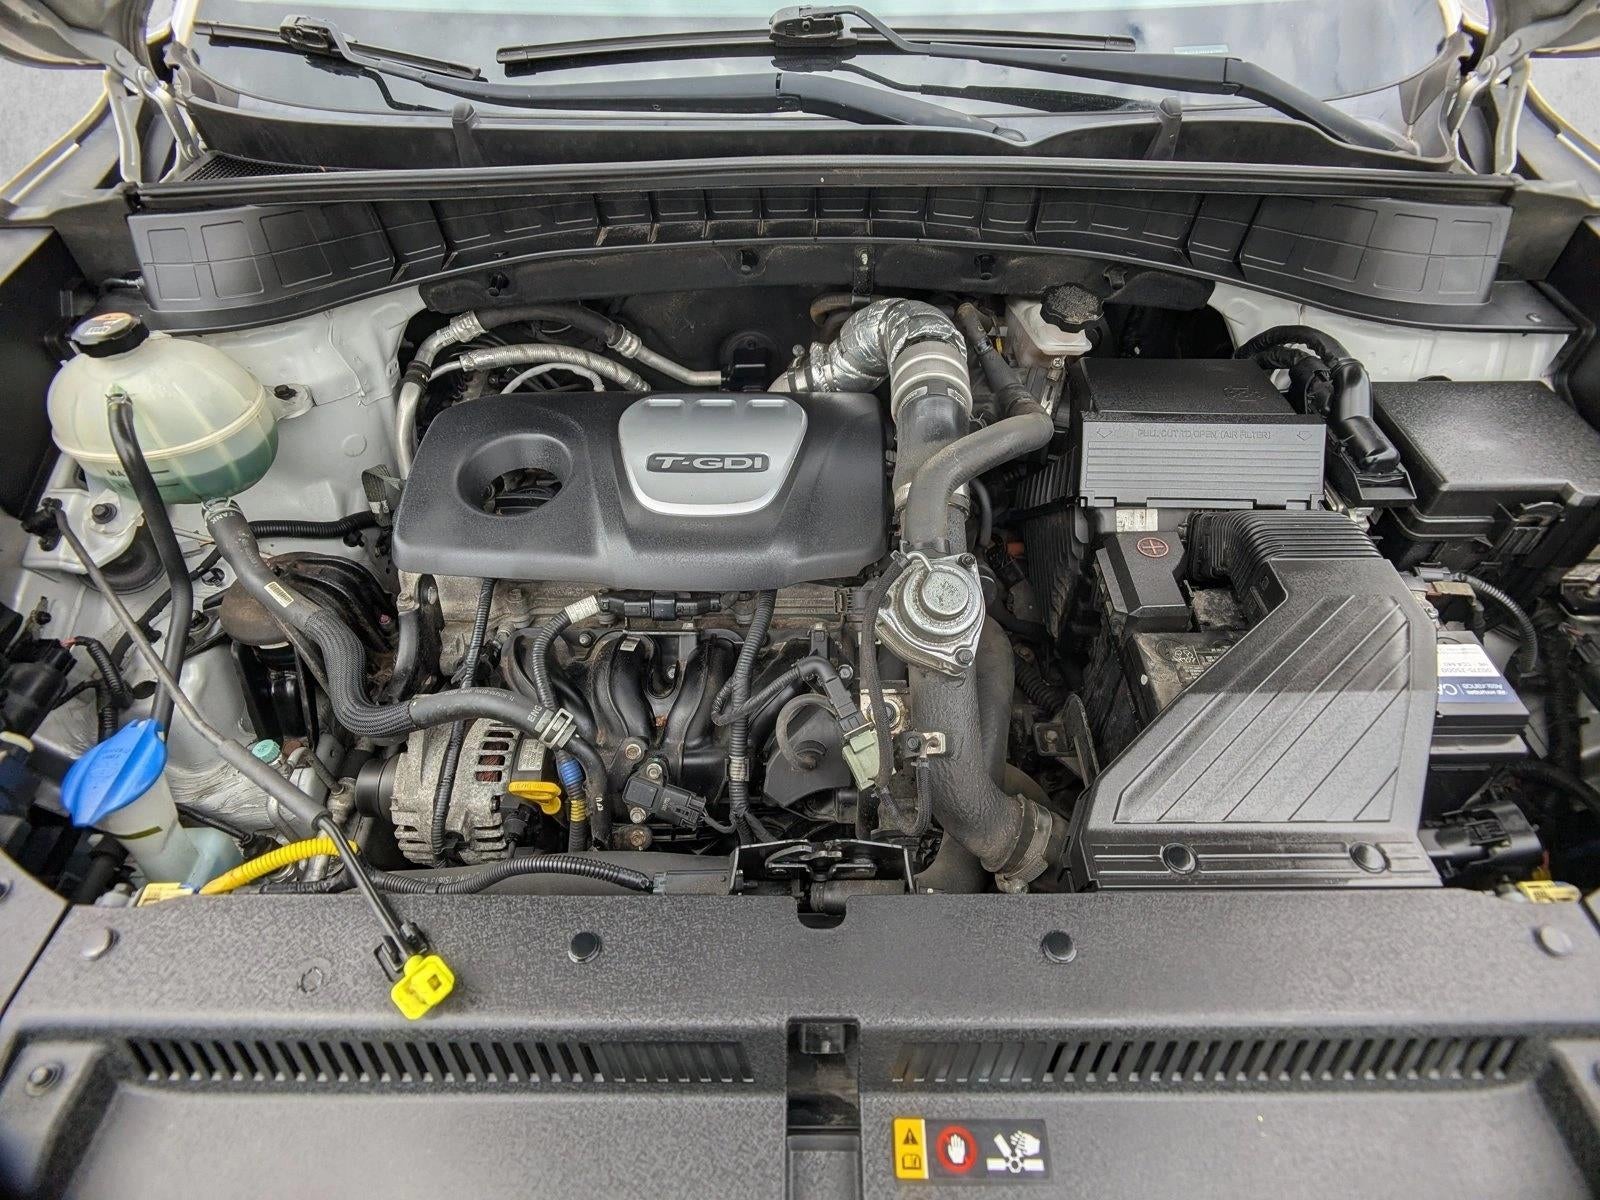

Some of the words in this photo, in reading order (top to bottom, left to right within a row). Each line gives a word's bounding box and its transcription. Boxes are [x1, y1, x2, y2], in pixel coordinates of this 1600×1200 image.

[655, 456, 762, 469] T-GDI
[210, 510, 236, 525] TANK
[527, 704, 543, 723] ENG
